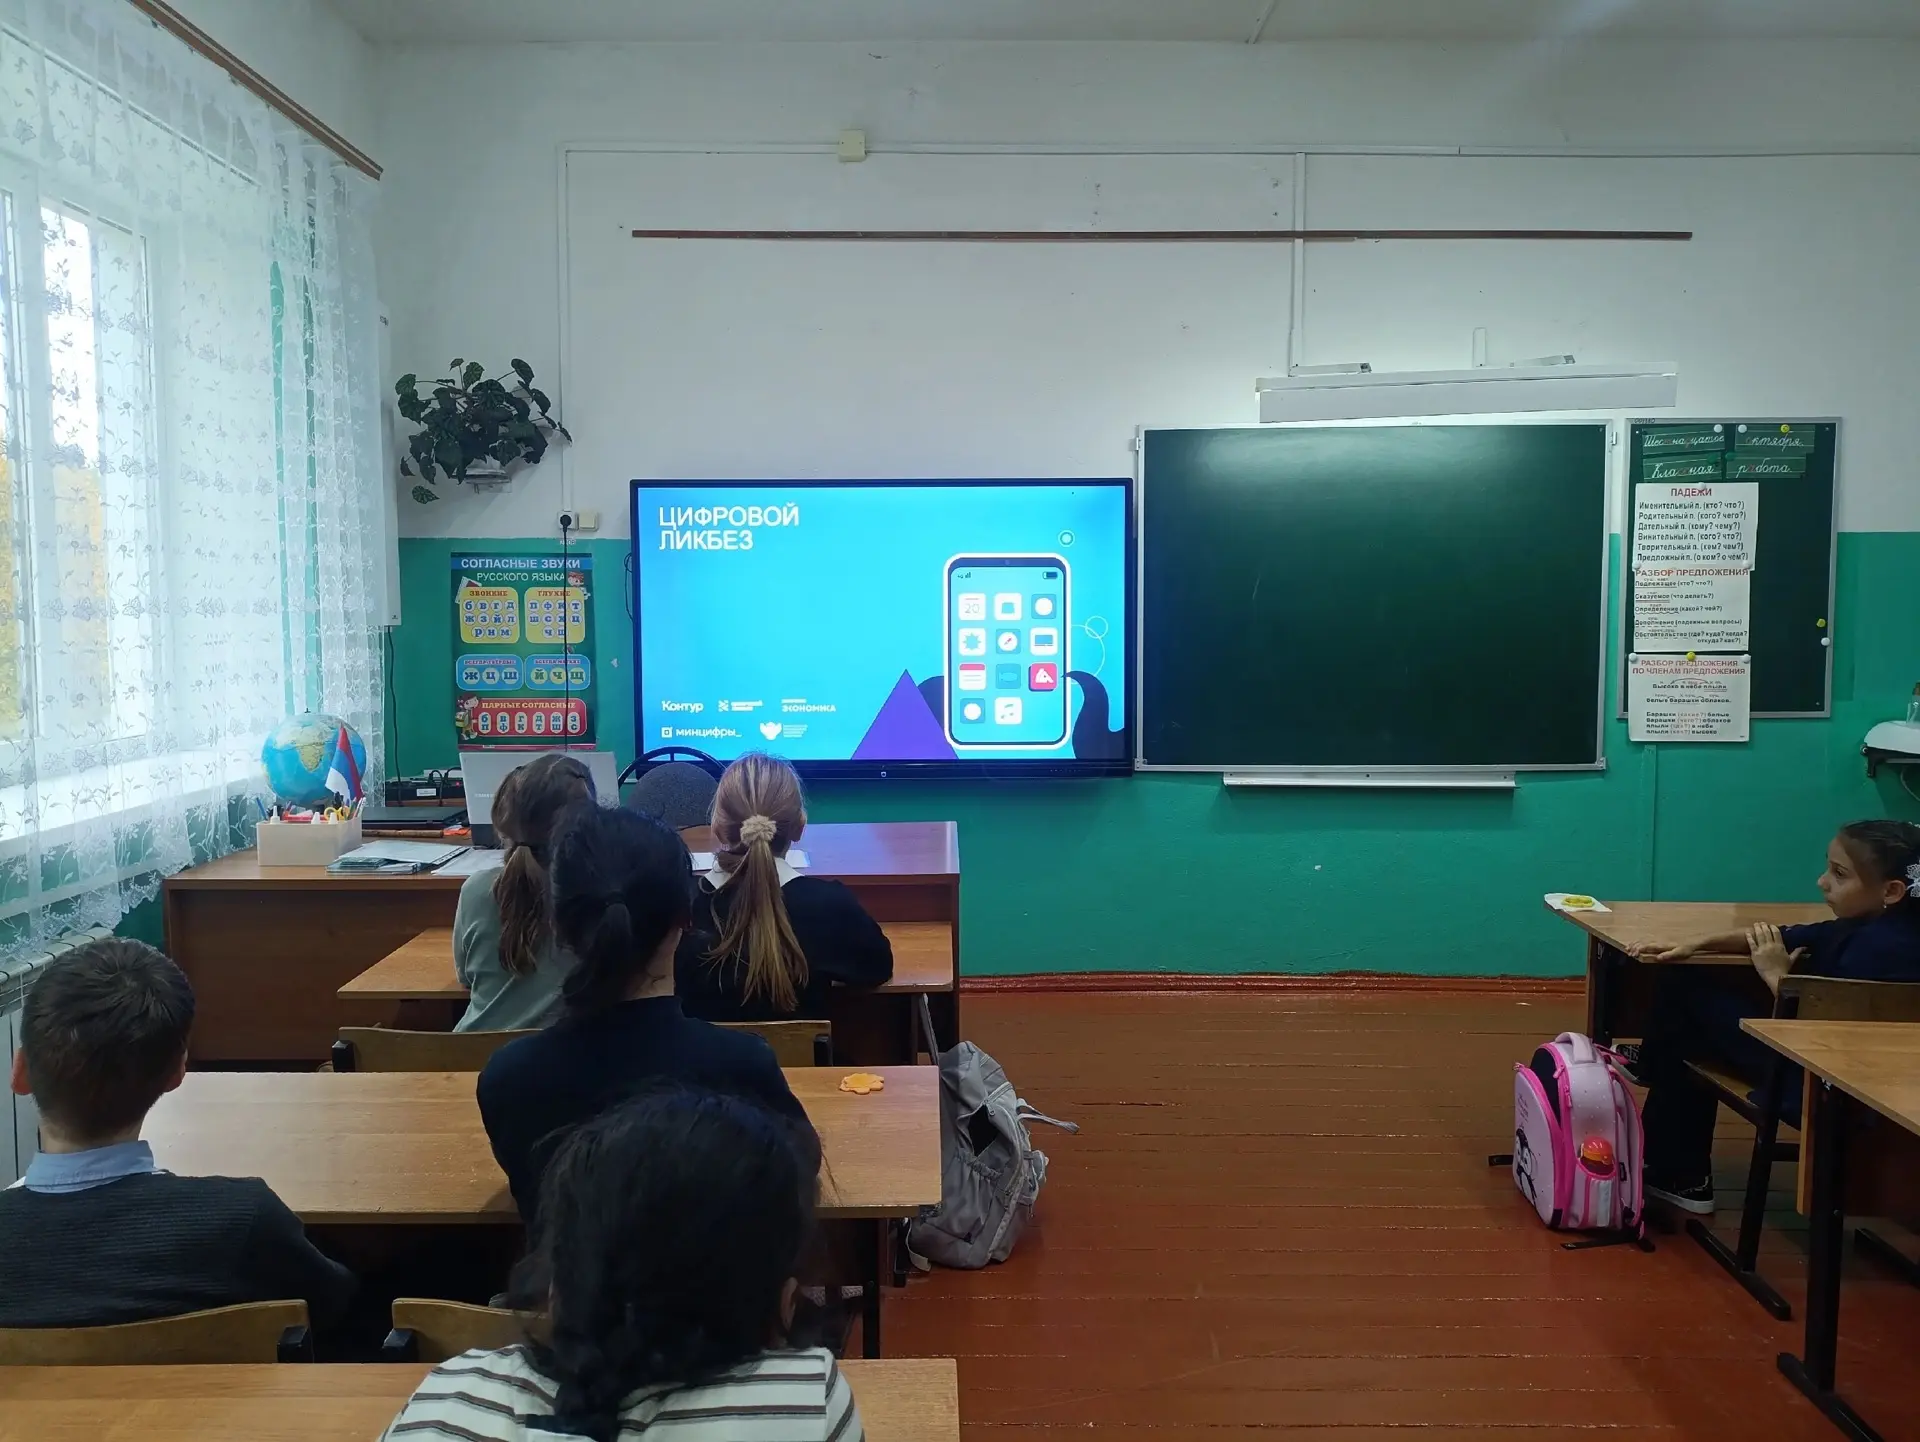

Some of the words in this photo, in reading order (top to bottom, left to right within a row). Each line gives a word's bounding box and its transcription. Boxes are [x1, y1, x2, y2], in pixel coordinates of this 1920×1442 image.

[1671, 488, 1712, 497] ПАДЕЖИ
[1703, 501, 1723, 510] (кто?
[1724, 501, 1745, 510] что?)
[659, 502, 799, 530] ЦИФРОВОЙ
[1639, 512, 1688, 520] Родительный
[1697, 511, 1721, 520] (кого?
[1722, 511, 1746, 520] чего?)
[1638, 522, 1680, 530] Дательный
[1688, 522, 1713, 531] (кому?
[1715, 522, 1741, 531] чему?)
[659, 529, 754, 550] ЛИКБЕЗ
[1638, 532, 1689, 540] Винительный
[1697, 532, 1721, 541] (кого?
[1722, 532, 1742, 541] что?)
[1638, 543, 1692, 551] Творительный
[1700, 543, 1721, 552] (кем?
[1723, 543, 1744, 551] чем?)
[1638, 554, 1685, 562] Предложный
[1727, 553, 1749, 562] чем?)
[461, 558, 537, 569] СОГЛАСНЫЕ
[541, 559, 581, 569] ЗВУКИ
[476, 572, 529, 581] РУССКОГО
[531, 572, 565, 581] ЯЗЫКА
[1635, 569, 1674, 577] РАЗБОР
[1676, 568, 1749, 577] ПРЕДЛОЖЕНИЯ
[661, 700, 704, 713] Контур
